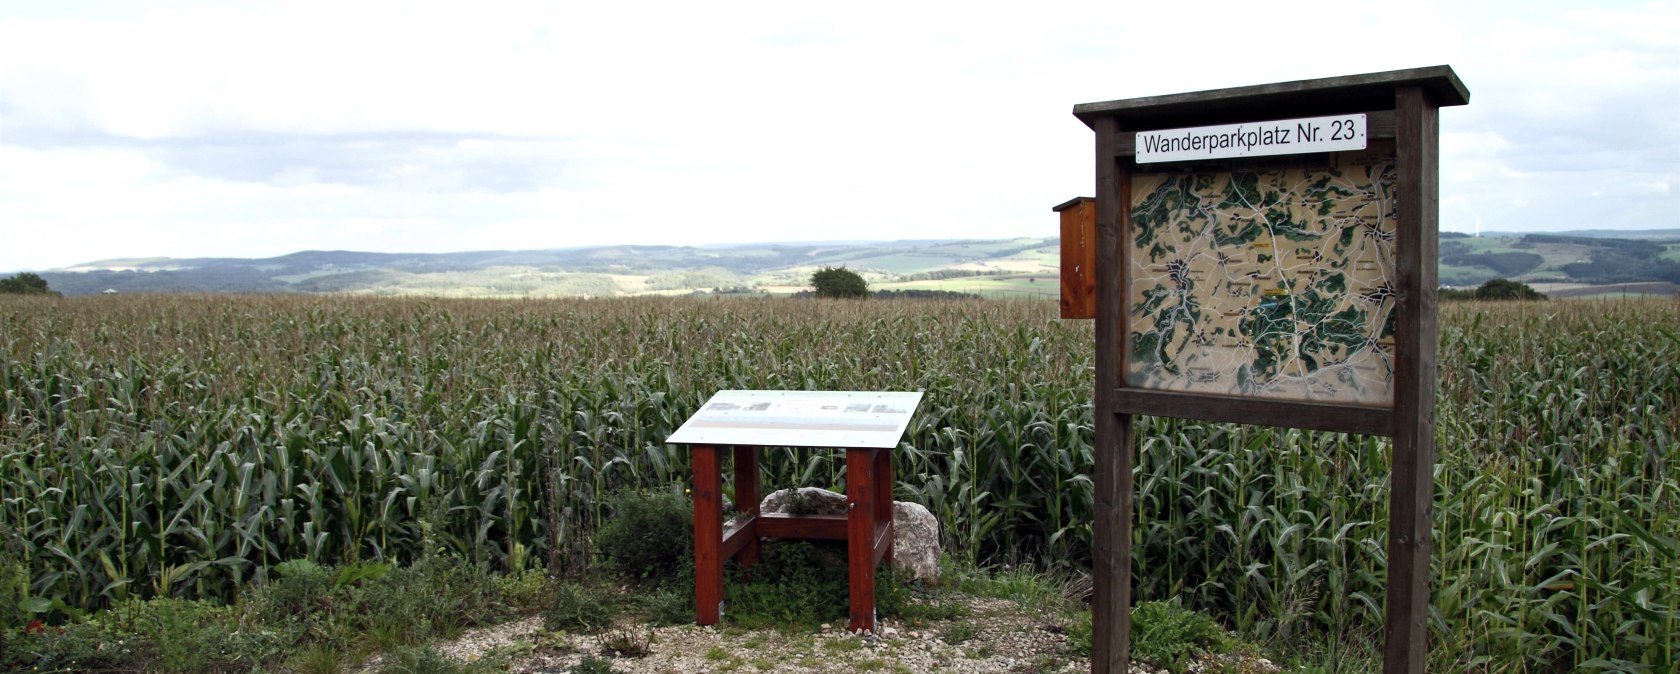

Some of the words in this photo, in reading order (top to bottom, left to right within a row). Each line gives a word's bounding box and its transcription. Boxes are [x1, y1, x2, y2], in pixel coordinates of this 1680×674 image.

[1144, 127, 1290, 154] Wanderparkplatz
[1297, 122, 1323, 143] Nr.
[1330, 119, 1355, 141] 23
